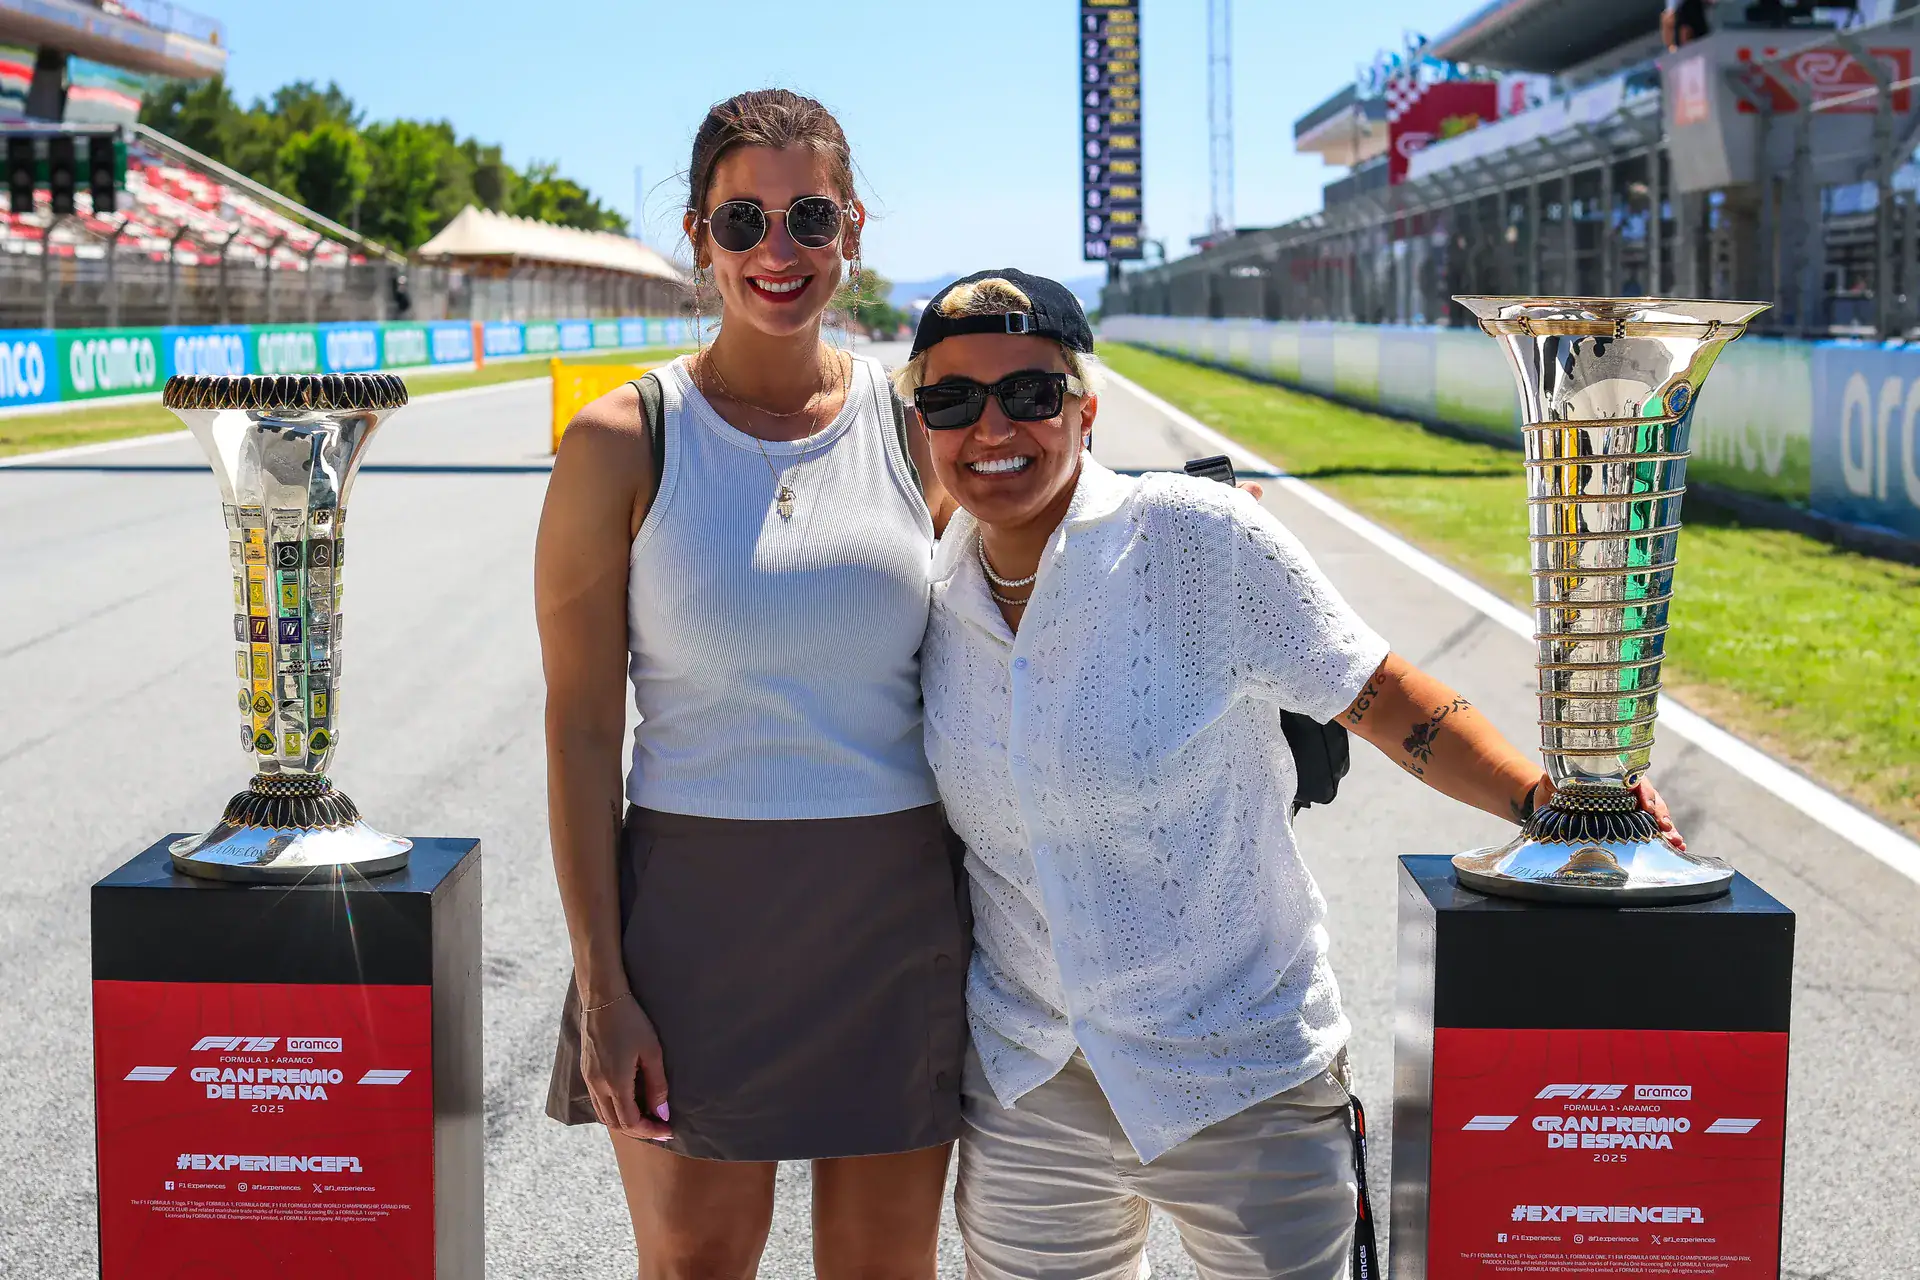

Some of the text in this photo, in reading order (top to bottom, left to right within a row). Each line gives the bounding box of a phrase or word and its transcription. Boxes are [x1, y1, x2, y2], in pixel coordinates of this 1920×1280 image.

[70, 337, 156, 392] aramco
[291, 1040, 339, 1049] aramco
[190, 1068, 343, 1084] GRAN PREMIO
[206, 1084, 328, 1100] DE ESPAÑA
[1638, 1088, 1688, 1097] aramco
[1532, 1116, 1691, 1133] GRAN PREMIO
[1548, 1133, 1673, 1150] DE ESPAÑA
[176, 1153, 363, 1173] #EXPERIENCEF1
[1593, 1154, 1627, 1162] 2025
[1512, 1205, 1704, 1224] #EXPERIENCEF1
